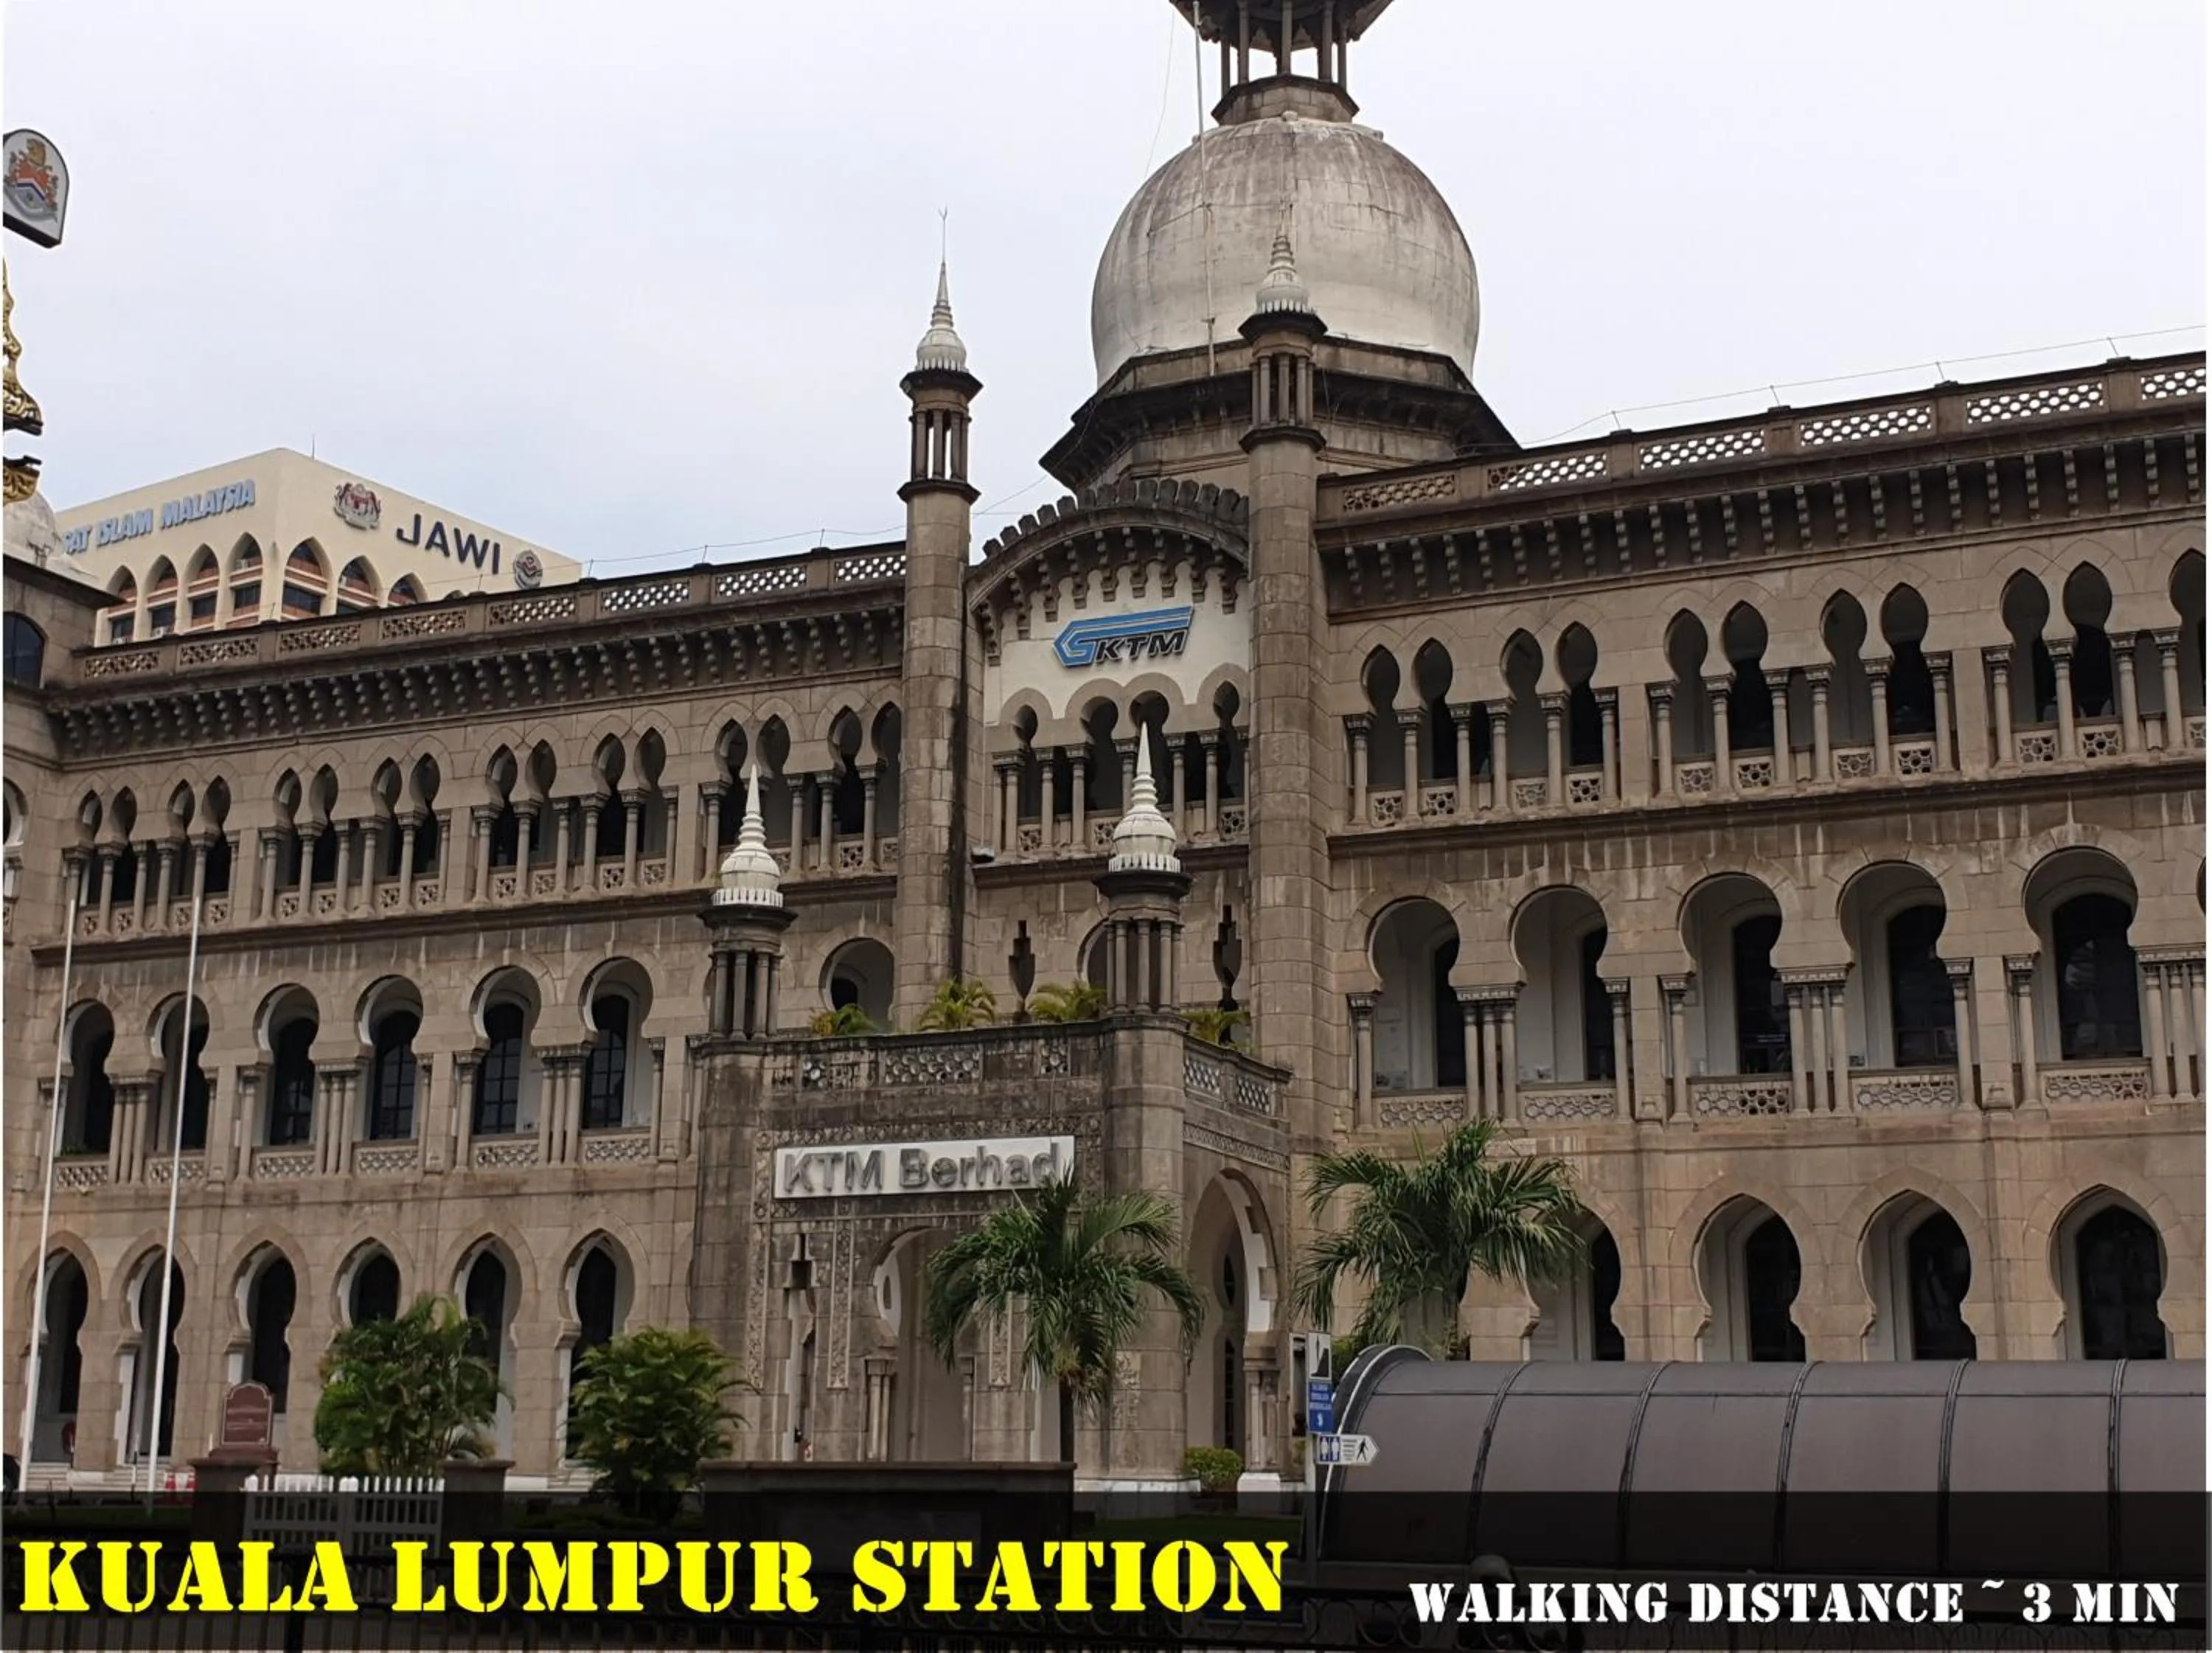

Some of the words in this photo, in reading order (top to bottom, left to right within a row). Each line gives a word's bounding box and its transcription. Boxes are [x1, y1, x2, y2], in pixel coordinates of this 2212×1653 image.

[97, 507, 154, 548] ISLAM
[160, 478, 256, 529] MALAYSIA
[396, 513, 501, 575] JAWI
[1094, 628, 1189, 664] KTM
[783, 1148, 883, 1194] KTM
[898, 1141, 1060, 1189] Berhad
